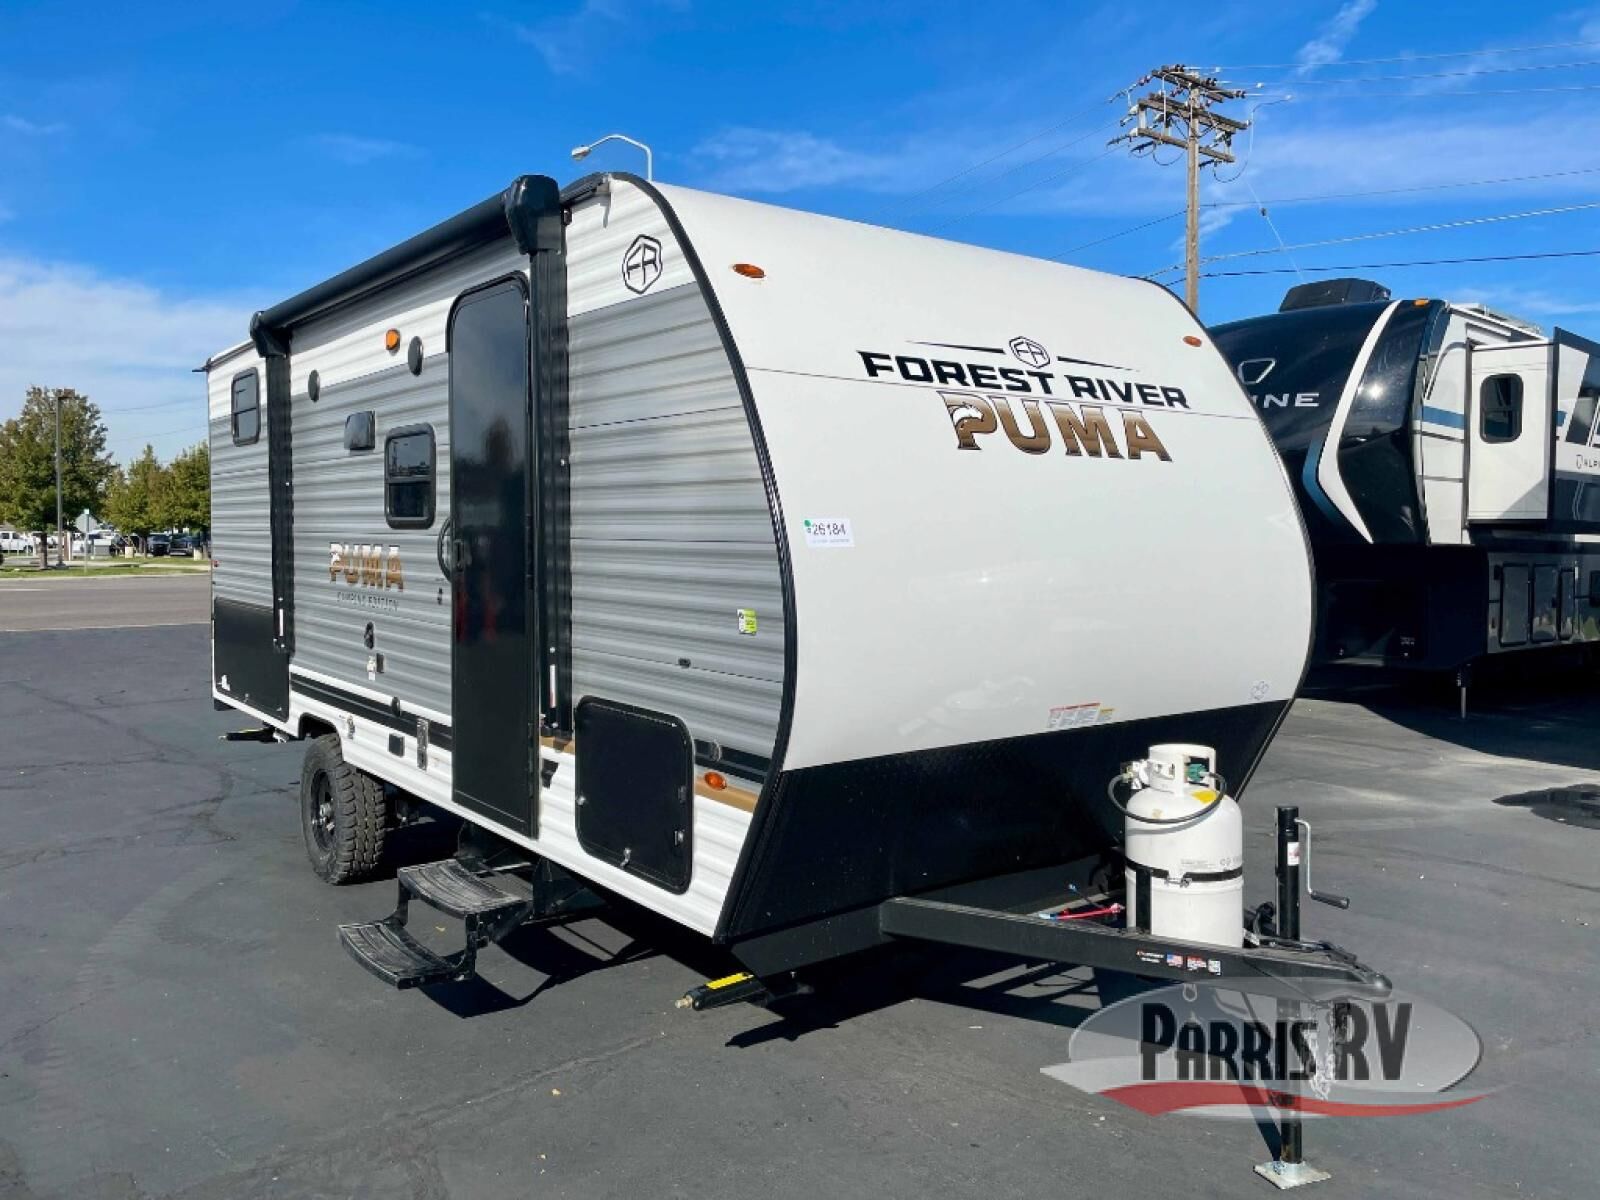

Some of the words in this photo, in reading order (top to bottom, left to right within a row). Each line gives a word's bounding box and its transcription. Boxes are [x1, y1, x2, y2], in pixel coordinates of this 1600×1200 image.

[858, 351, 1055, 395] FOREST
[1064, 374, 1192, 410] RIVER
[936, 390, 1173, 462] PUMA
[329, 541, 404, 592] PUMA
